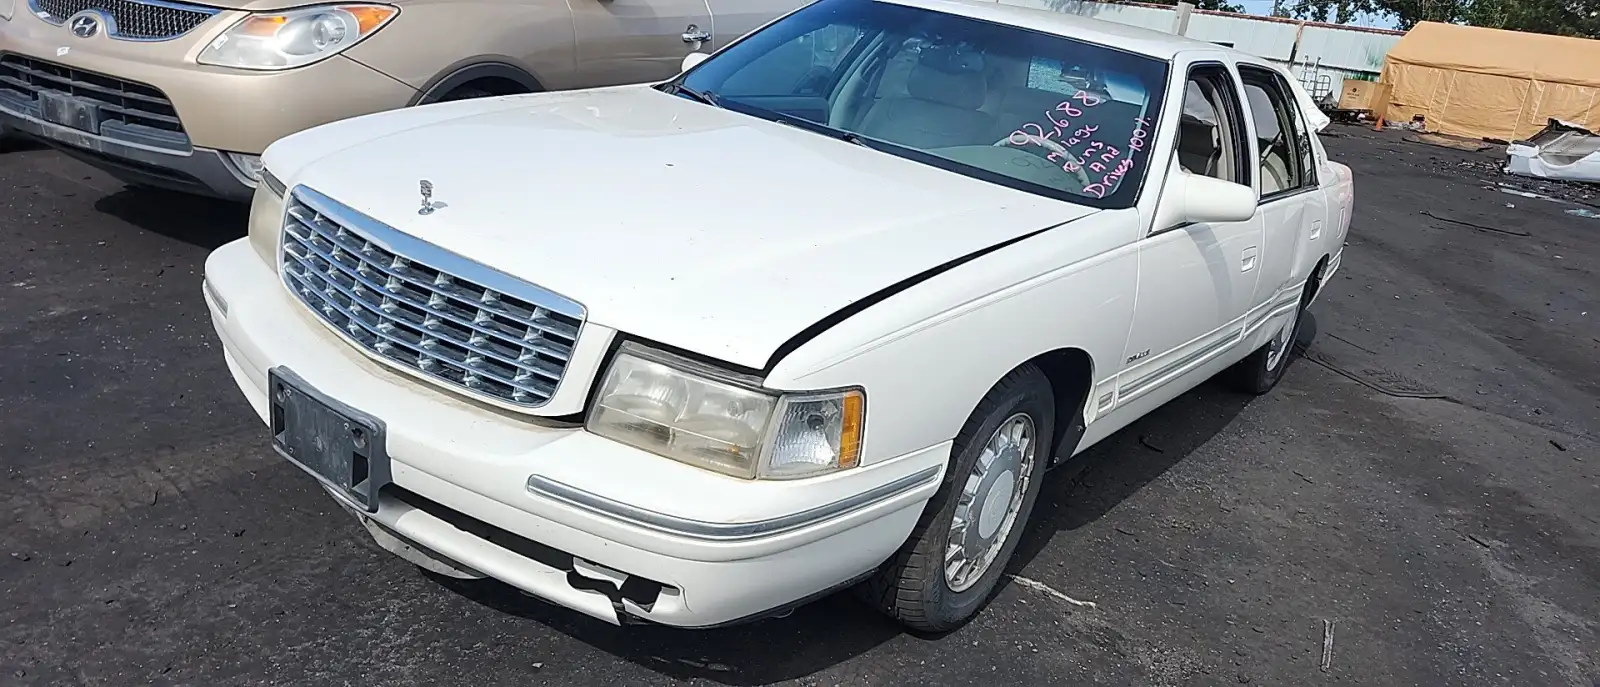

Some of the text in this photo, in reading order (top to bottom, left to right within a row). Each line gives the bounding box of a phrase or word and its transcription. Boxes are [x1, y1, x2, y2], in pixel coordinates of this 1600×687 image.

[1062, 141, 1104, 173] Runs
[1089, 146, 1120, 173] And
[1082, 159, 1134, 199] Drives
